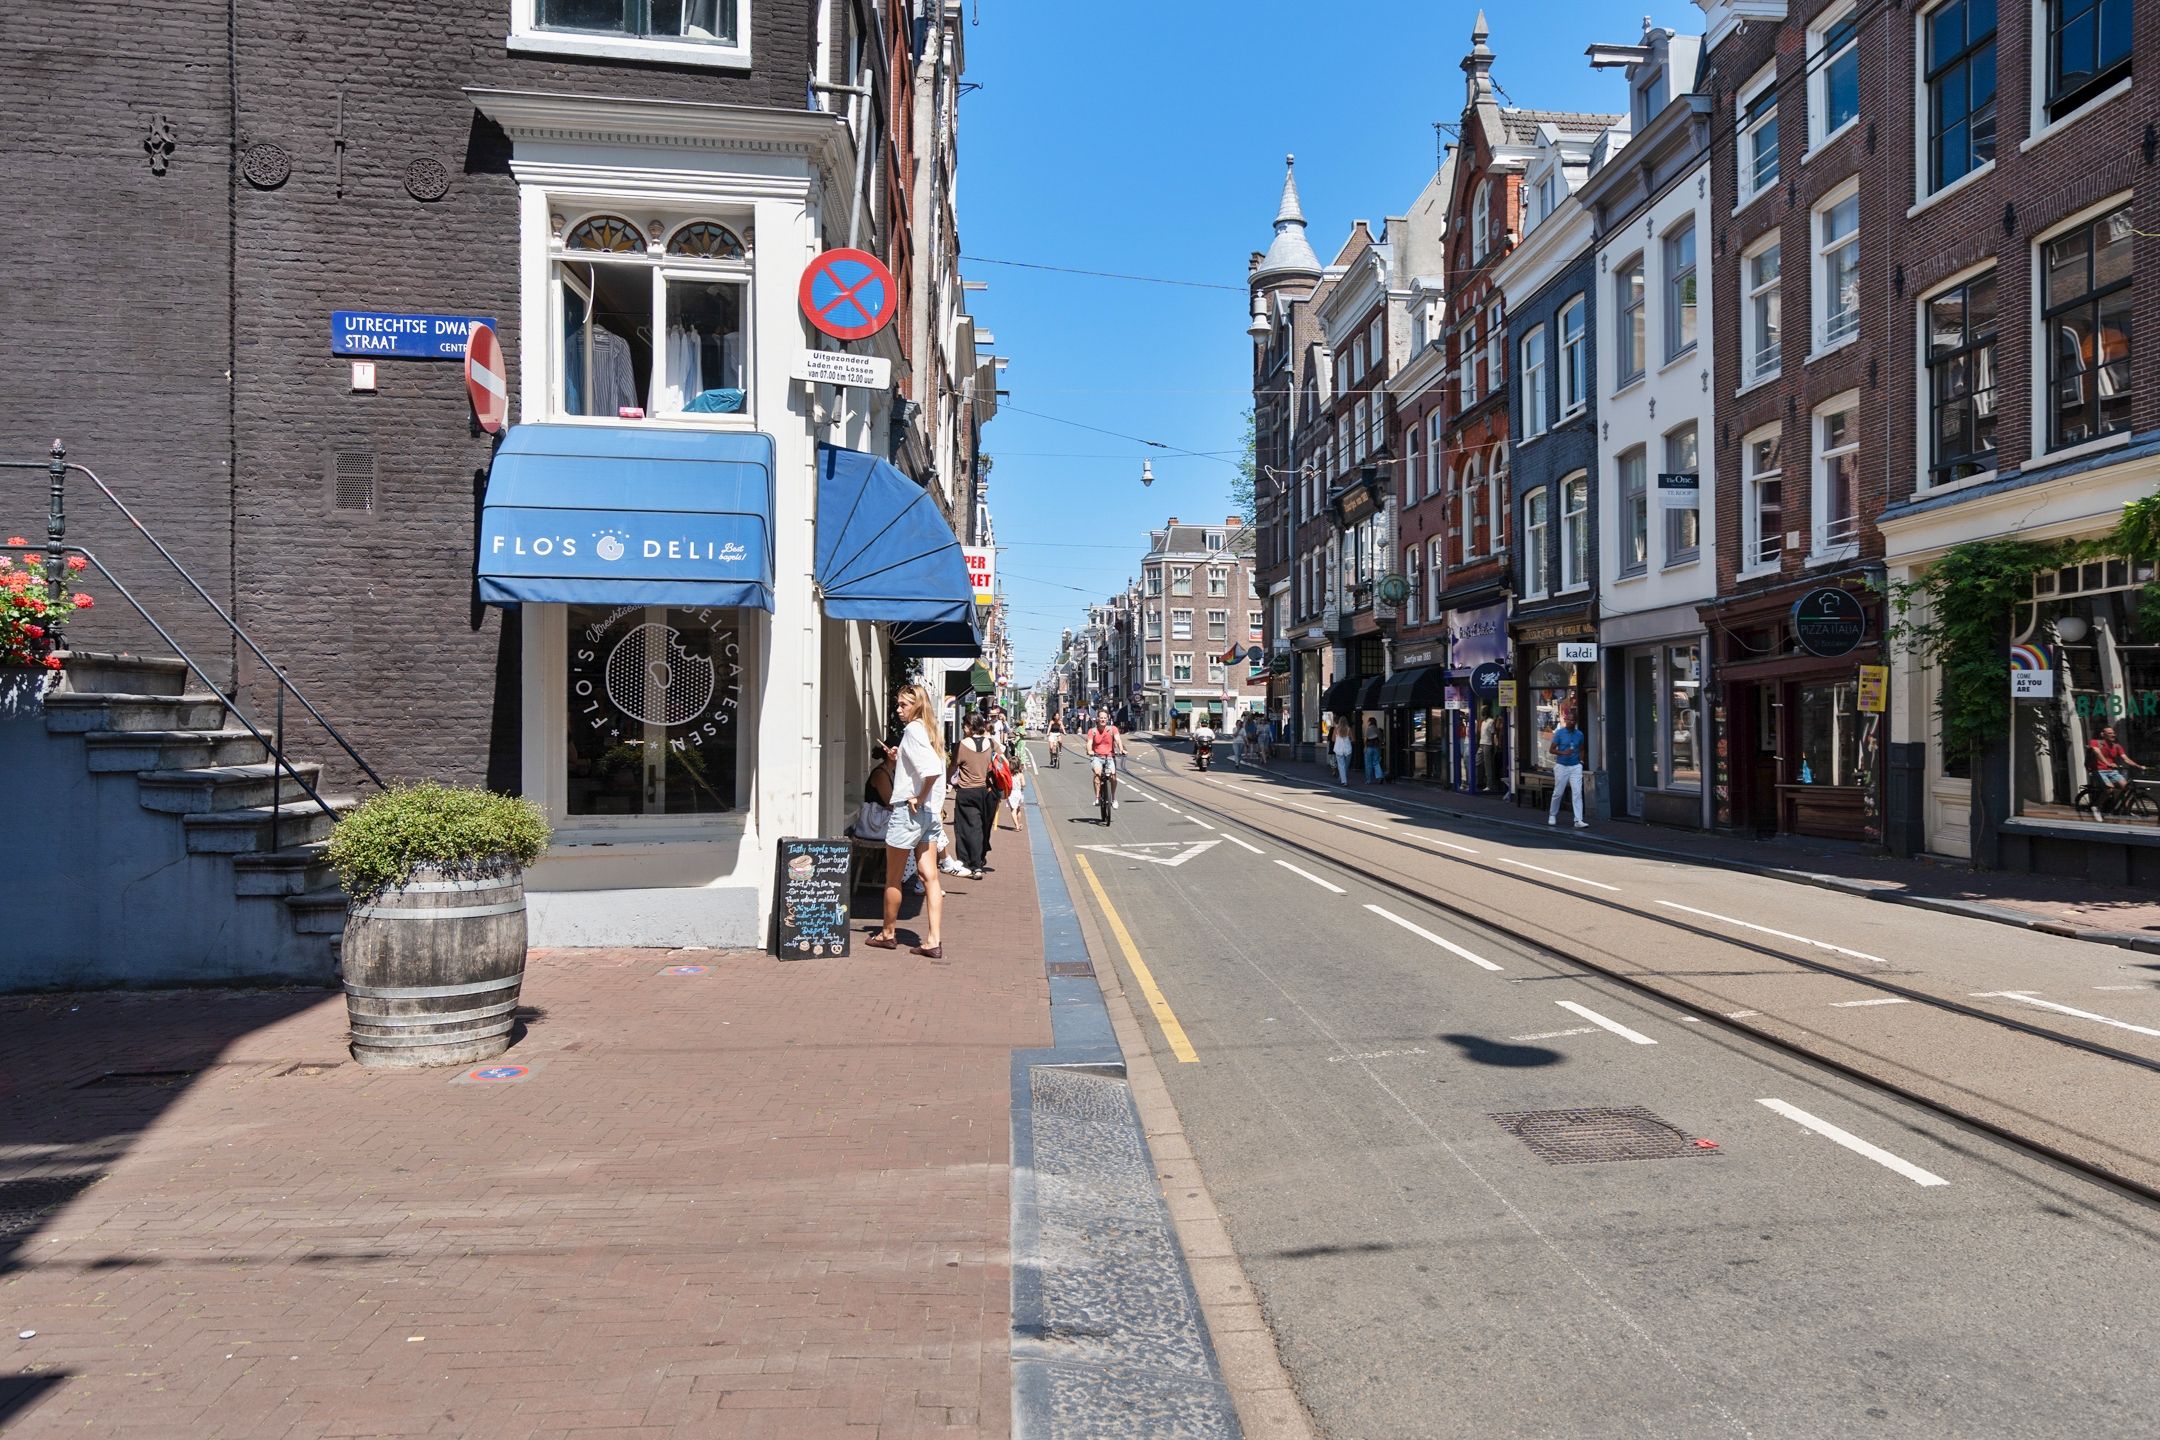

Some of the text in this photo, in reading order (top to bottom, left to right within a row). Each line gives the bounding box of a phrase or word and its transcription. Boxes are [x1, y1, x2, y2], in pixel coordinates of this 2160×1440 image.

[345, 317, 471, 336] UTRECHTSE DWA
[345, 334, 398, 350] STRAAT
[813, 353, 869, 365] Uitgezonderd
[807, 361, 831, 370] Laden
[846, 366, 873, 375] Lossen
[820, 370, 835, 380] 07.00
[848, 373, 863, 384] 12.00
[864, 377, 874, 385] uur
[493, 535, 714, 560] FLO'S DELI
[721, 542, 745, 553] Best
[1801, 624, 1829, 635] PIZZA
[1566, 647, 1592, 659] kaldi
[574, 649, 608, 730] FLO'S
[2075, 690, 2158, 718] BABAR
[808, 844, 828, 856] bagels
